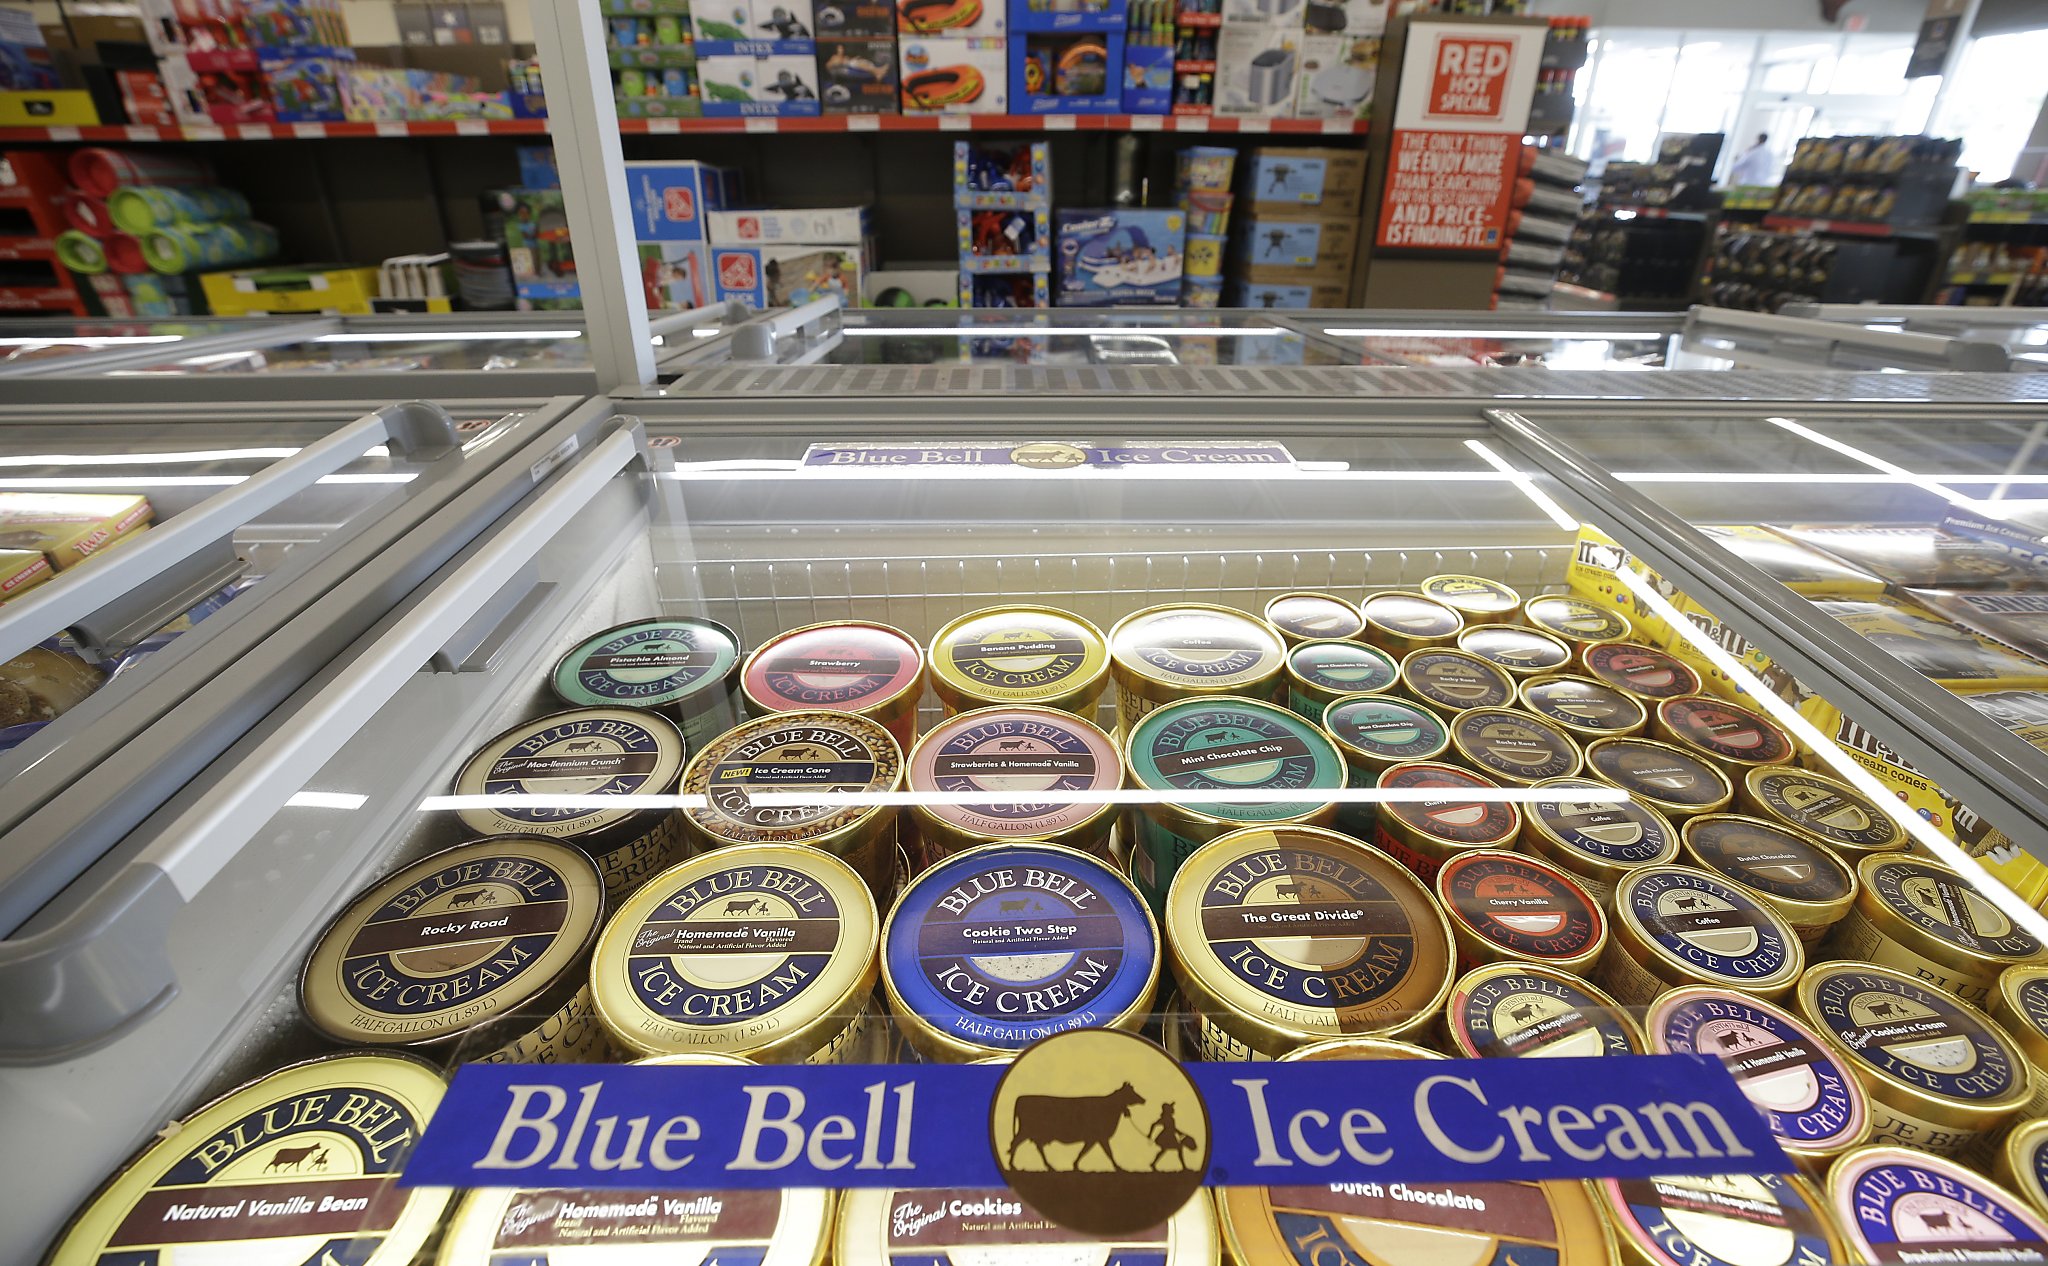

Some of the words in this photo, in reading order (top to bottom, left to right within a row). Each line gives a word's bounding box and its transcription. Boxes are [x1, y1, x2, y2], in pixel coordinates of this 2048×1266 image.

[734, 41, 774, 54] INTEX
[1440, 43, 1509, 76] RED
[1450, 76, 1491, 94] HOT
[740, 103, 779, 115] INTEX
[1440, 95, 1491, 112] SPECIAL
[1401, 132, 1428, 150] THE
[1428, 134, 1465, 151] ONLY
[1466, 135, 1508, 152] THING
[1398, 151, 1424, 172] WE
[1422, 151, 1464, 173] ENJOY
[1462, 153, 1504, 174] MORE
[1394, 172, 1430, 189] THAN
[1430, 173, 1502, 192] SEARCHING
[1392, 204, 1431, 224] AND
[1386, 224, 1403, 243] IS
[1403, 225, 1466, 245] FINDING
[829, 451, 907, 464] Blue
[918, 451, 984, 463] Bell
[1097, 450, 1150, 463] Ice
[1161, 450, 1278, 463] Cream
[72, 528, 110, 555] Twix
[964, 662, 998, 681] ICE
[1003, 658, 1075, 685] CREAM
[1146, 652, 1176, 669] ICE
[1183, 653, 1254, 674] CREAM
[585, 672, 614, 692] ICE
[614, 671, 697, 696] CREAM
[772, 676, 799, 695] ICE
[801, 678, 880, 701] CREAM
[527, 759, 589, 769] Moo-llennium
[1181, 756, 1205, 765] Mint
[1207, 748, 1257, 761] Chocolate
[1259, 744, 1283, 753] Chip
[723, 768, 752, 778] NEW!
[1852, 752, 1888, 775] cream
[1890, 768, 1928, 791] cones
[493, 819, 519, 834] HALF
[518, 825, 565, 836] GALLON
[566, 818, 591, 832] (1.89
[592, 815, 604, 825] L)
[388, 861, 483, 914] BLUE
[1213, 853, 1287, 900] BLUE
[665, 869, 753, 916] BLUE
[937, 869, 1018, 915] BLUE
[1490, 899, 1518, 907] Cherry
[420, 921, 465, 936] Rocky
[469, 916, 509, 929] Road
[1241, 913, 1268, 924] The
[1270, 911, 1312, 923] Great
[753, 927, 796, 938] Vanilla
[962, 926, 1011, 938] Cookie
[1014, 926, 1043, 935] Two
[1047, 923, 1077, 935] Step
[1480, 921, 1520, 946] ICE
[1534, 918, 1588, 952] CREAM
[1675, 941, 1719, 969] ICE
[1732, 933, 1781, 974] CREAM
[351, 960, 399, 1001] ICE
[395, 944, 532, 1007] CREAM
[1228, 945, 1289, 990] ICE
[1302, 940, 1404, 1000] CREAM
[638, 962, 684, 1006] ICE
[681, 962, 810, 1018] CREAM
[936, 963, 991, 1006] ICE
[995, 956, 1109, 1014] CREAM
[350, 1013, 385, 1031] HALF
[382, 1016, 444, 1034] GALLON
[448, 1003, 481, 1026] (1.89
[480, 998, 498, 1012] L)
[1916, 1021, 1948, 1032] Cream
[1503, 1027, 1540, 1046] Ultimate
[1537, 1011, 1582, 1031] Neapolitan
[1744, 1061, 1751, 1070] &
[1782, 1047, 1807, 1059] Vanilla
[1884, 1056, 1942, 1089] ICE
[1954, 1043, 2007, 1094] CREAM
[1797, 1072, 1846, 1136] CREAM
[472, 1080, 702, 1172] Blue
[725, 1080, 917, 1172] Bell
[1230, 1077, 1396, 1167] Ice
[1413, 1073, 1756, 1165] Cream
[191, 1093, 333, 1175] BLUE
[162, 1200, 243, 1223] Natural
[248, 1197, 316, 1215] Vanilla
[317, 1195, 369, 1212] Bean
[663, 1196, 722, 1216] Vanilla
[949, 1199, 1022, 1217] Cookies
[1330, 1183, 1385, 1198] Dutch
[1389, 1183, 1487, 1212] Chocolate
[554, 1218, 582, 1228] Brand
[679, 1213, 719, 1224] Flavored
[558, 1227, 591, 1238] Natural
[592, 1226, 610, 1237] and
[611, 1225, 650, 1237] Artificial
[651, 1224, 679, 1234] Flavor
[680, 1223, 709, 1234] Added
